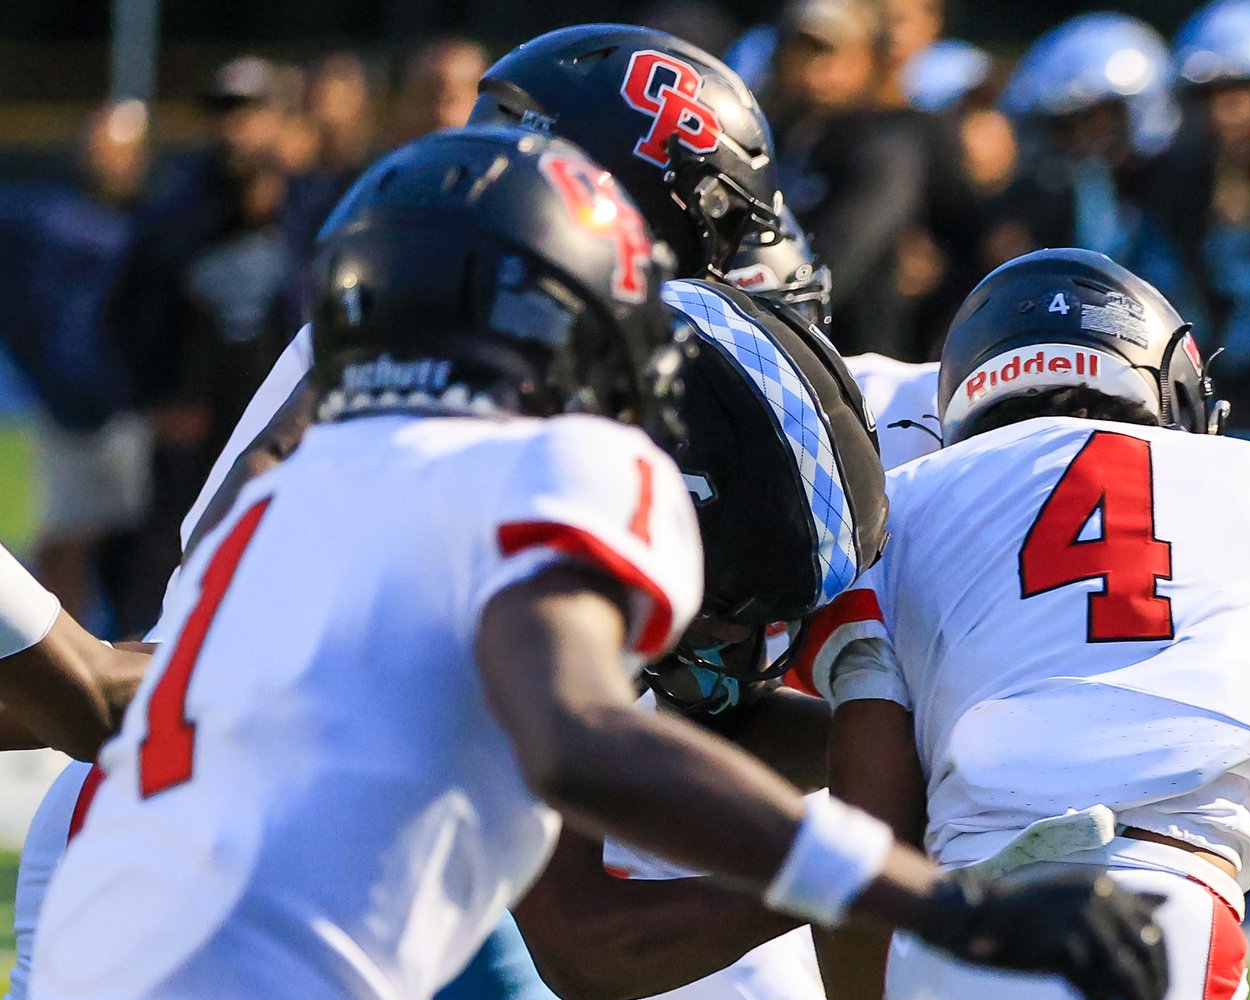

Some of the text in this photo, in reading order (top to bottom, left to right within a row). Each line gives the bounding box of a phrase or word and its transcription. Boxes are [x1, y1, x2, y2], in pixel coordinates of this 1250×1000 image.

[1048, 293, 1070, 315] 4
[966, 351, 1099, 405] Riddell
[629, 457, 653, 546] 1
[1018, 429, 1175, 643] 4
[138, 494, 275, 799] 1
